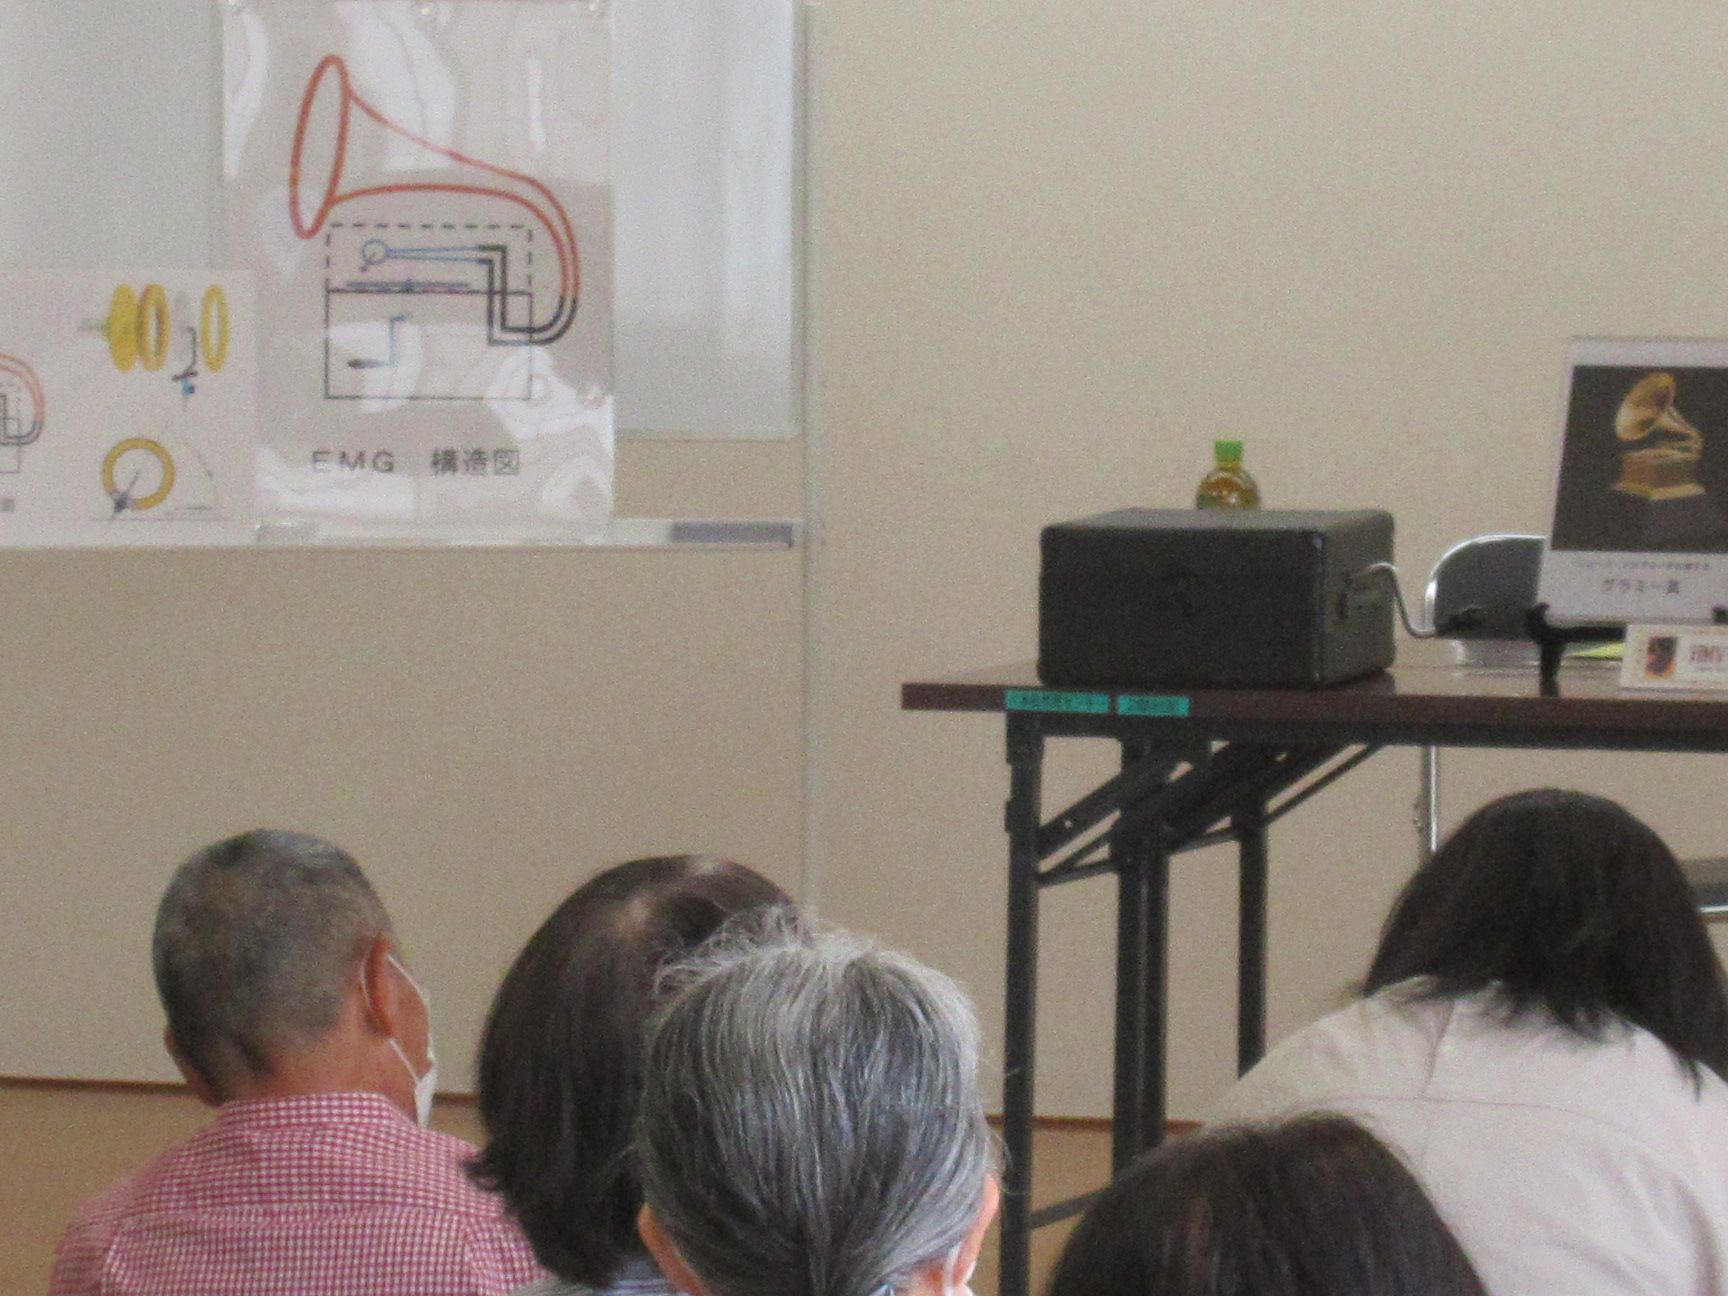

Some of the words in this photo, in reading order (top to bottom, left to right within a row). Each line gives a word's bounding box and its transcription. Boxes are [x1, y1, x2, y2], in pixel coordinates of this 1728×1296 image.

[311, 449, 396, 474] EMG
[430, 447, 521, 477] 構造図
